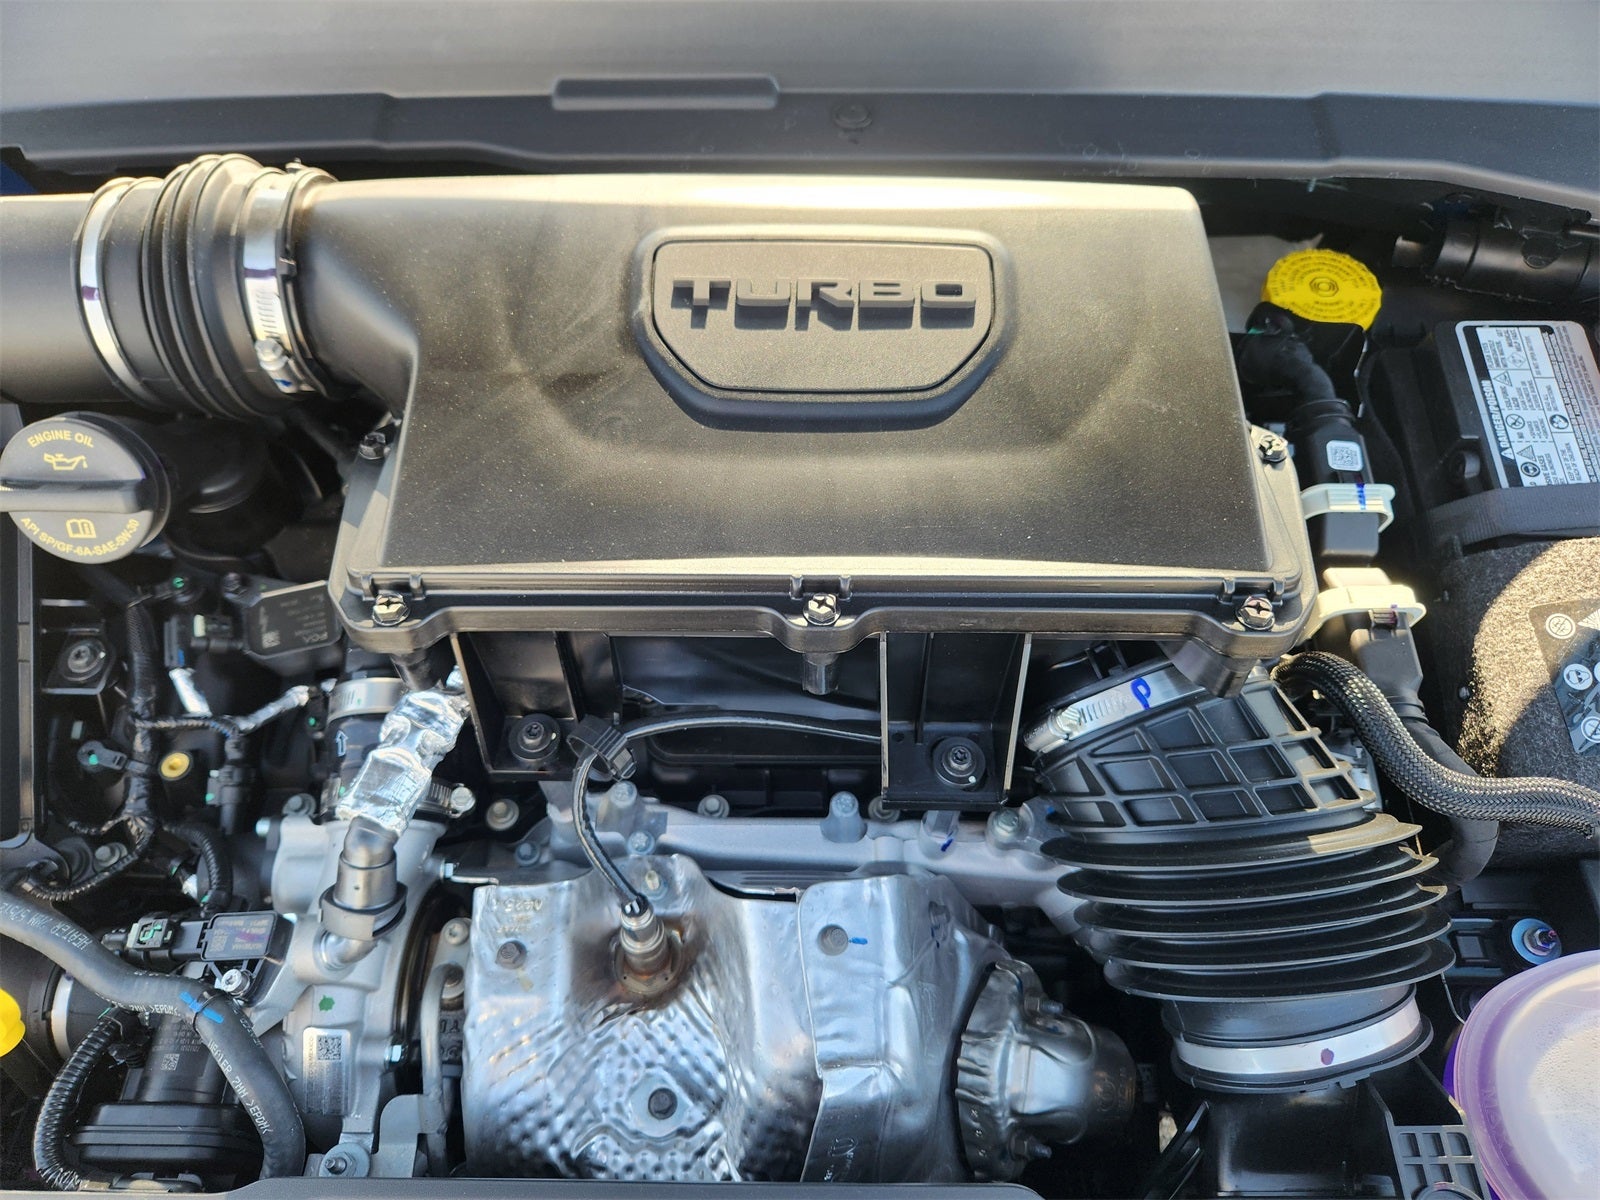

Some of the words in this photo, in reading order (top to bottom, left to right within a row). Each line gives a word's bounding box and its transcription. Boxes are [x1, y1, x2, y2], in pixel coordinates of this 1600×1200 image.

[671, 278, 977, 328] TURBO
[27, 429, 71, 448] ENGINE
[74, 432, 95, 448] OIL
[20, 518, 40, 536] API
